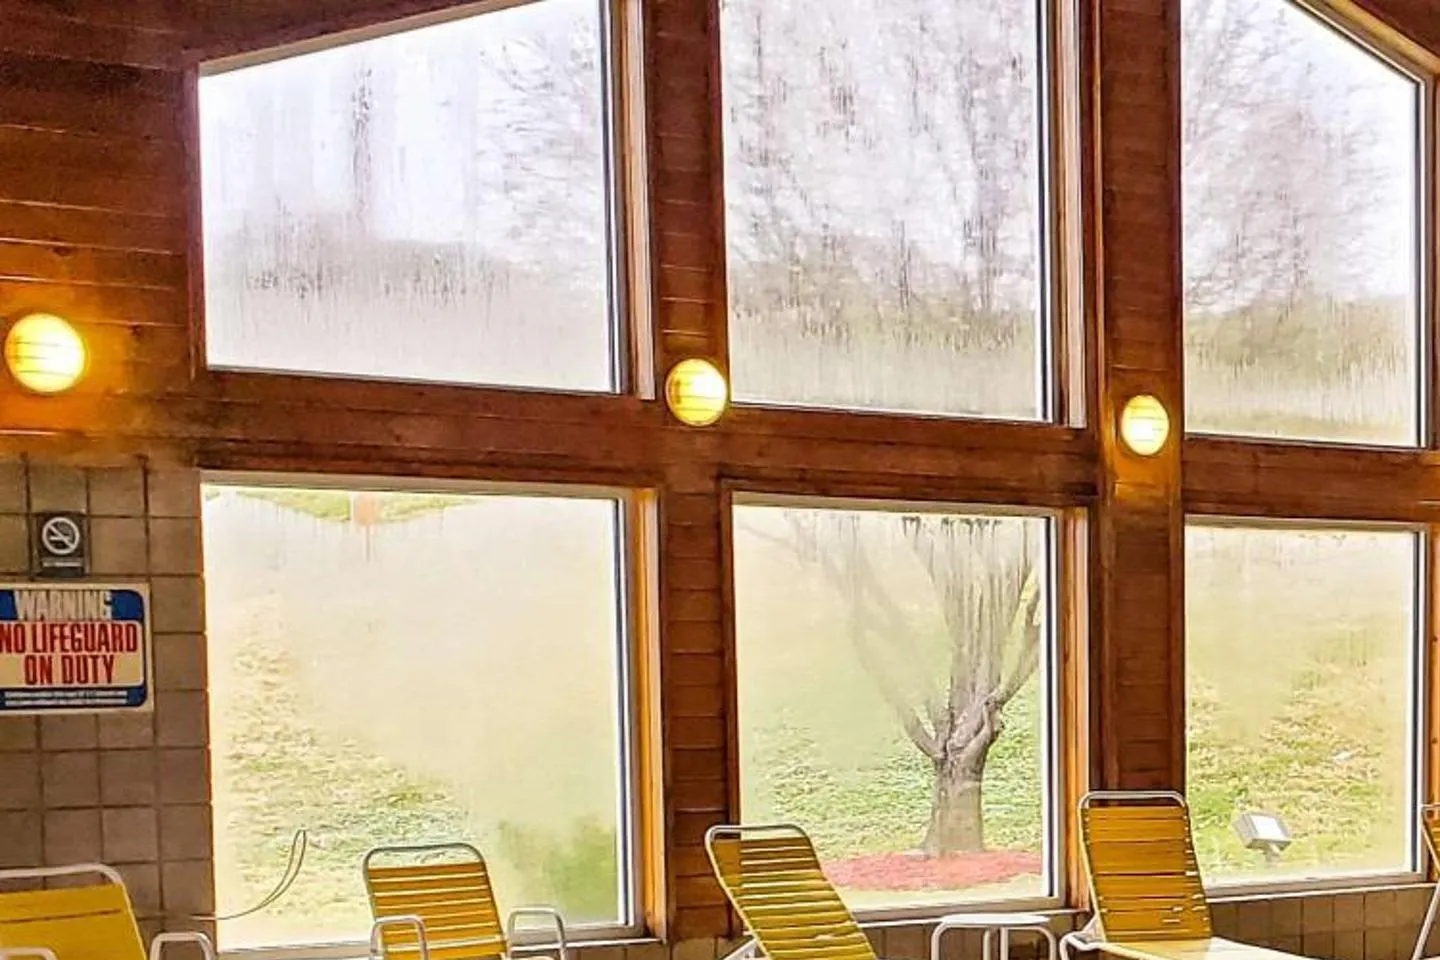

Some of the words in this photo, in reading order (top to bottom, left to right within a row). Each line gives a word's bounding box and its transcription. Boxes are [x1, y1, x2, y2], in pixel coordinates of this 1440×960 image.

[14, 590, 113, 620] WARNING
[0, 623, 26, 653] NO
[31, 623, 138, 653] LIFEGUARD
[24, 655, 53, 685] ON
[61, 655, 114, 684] DUTY
